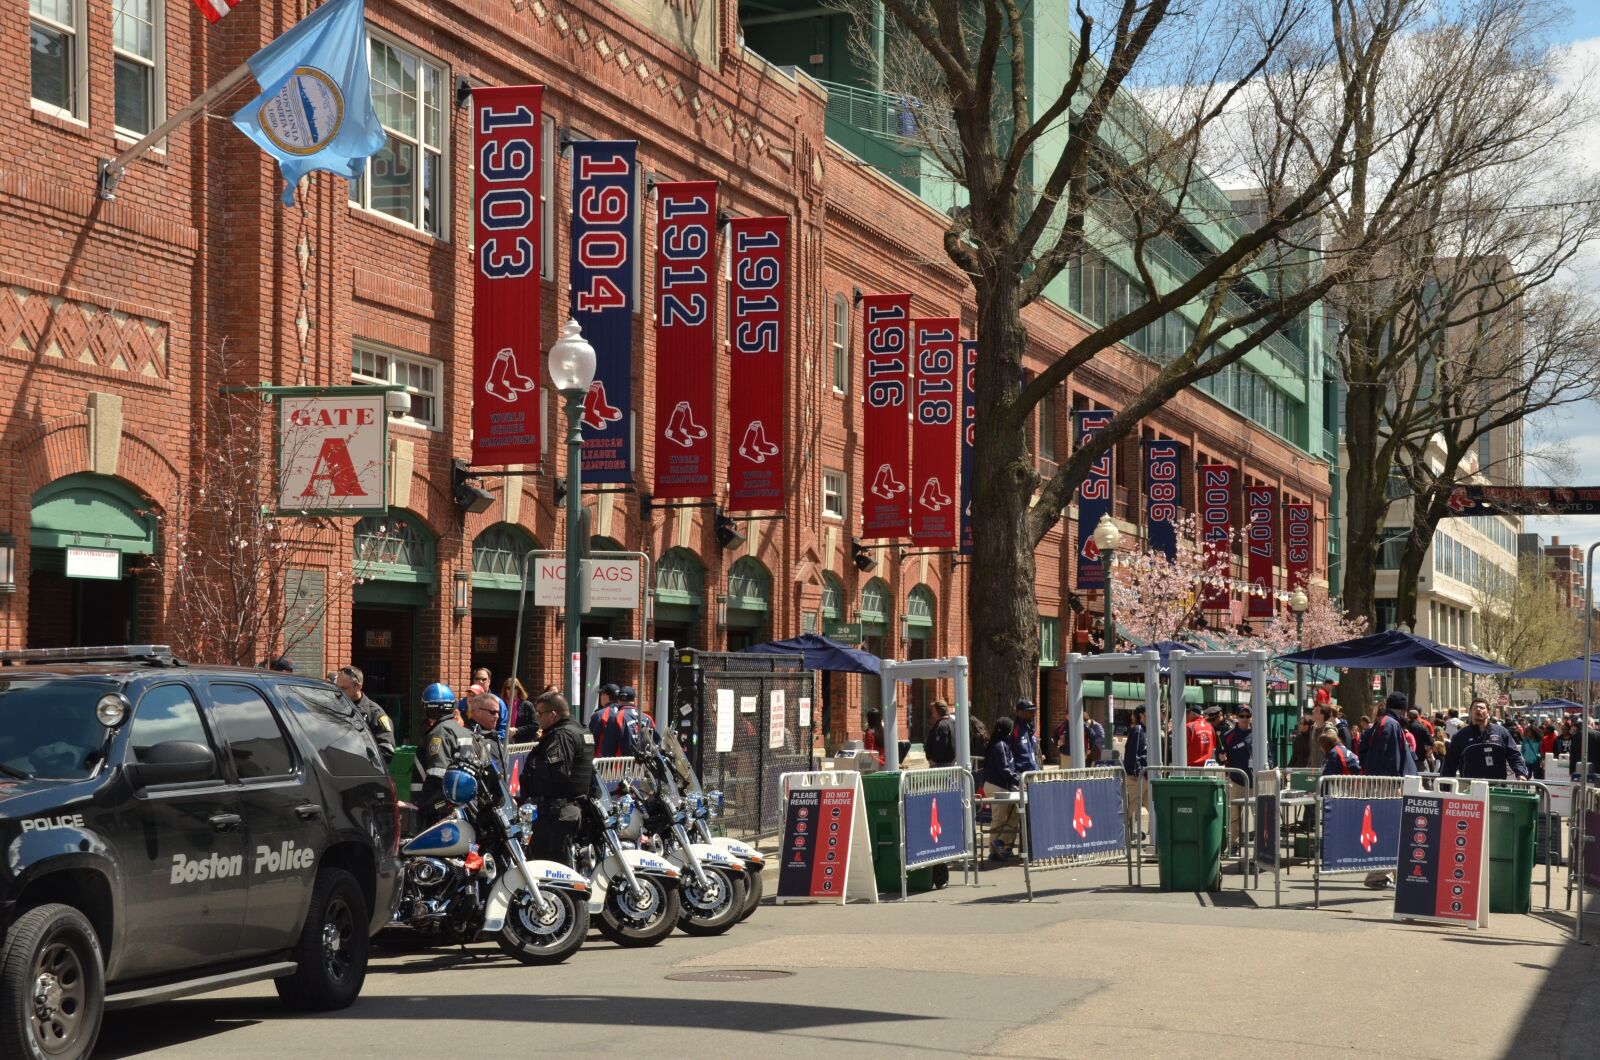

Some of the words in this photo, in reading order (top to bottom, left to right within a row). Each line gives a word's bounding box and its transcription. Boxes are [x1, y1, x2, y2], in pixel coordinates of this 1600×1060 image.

[480, 105, 534, 279] 1903
[578, 155, 629, 313] 1904
[662, 196, 709, 326] 1912
[736, 231, 780, 353] 1915
[868, 305, 905, 408] 1916
[918, 328, 954, 425] 1918
[291, 408, 374, 426] GATE
[300, 438, 368, 496] A
[1150, 447, 1176, 522] 1986
[1205, 470, 1230, 542] 2004
[1557, 503, 1582, 511] GATE
[1250, 491, 1272, 557] 2007
[1289, 508, 1309, 563] 2013
[592, 566, 633, 581] AGS
[790, 798, 818, 806] REMOVE
[1404, 805, 1439, 815] REMOVE
[1407, 799, 1438, 808] PLEASE
[1448, 801, 1460, 809] DO
[1462, 802, 1479, 810] NOT
[20, 813, 85, 833] POLICE
[1445, 809, 1481, 818] REMOVE
[706, 852, 728, 862] Police
[727, 844, 749, 853] Police
[170, 852, 243, 884] Boston
[254, 840, 315, 874] Police
[639, 858, 664, 868] Police
[545, 869, 571, 880] Police
